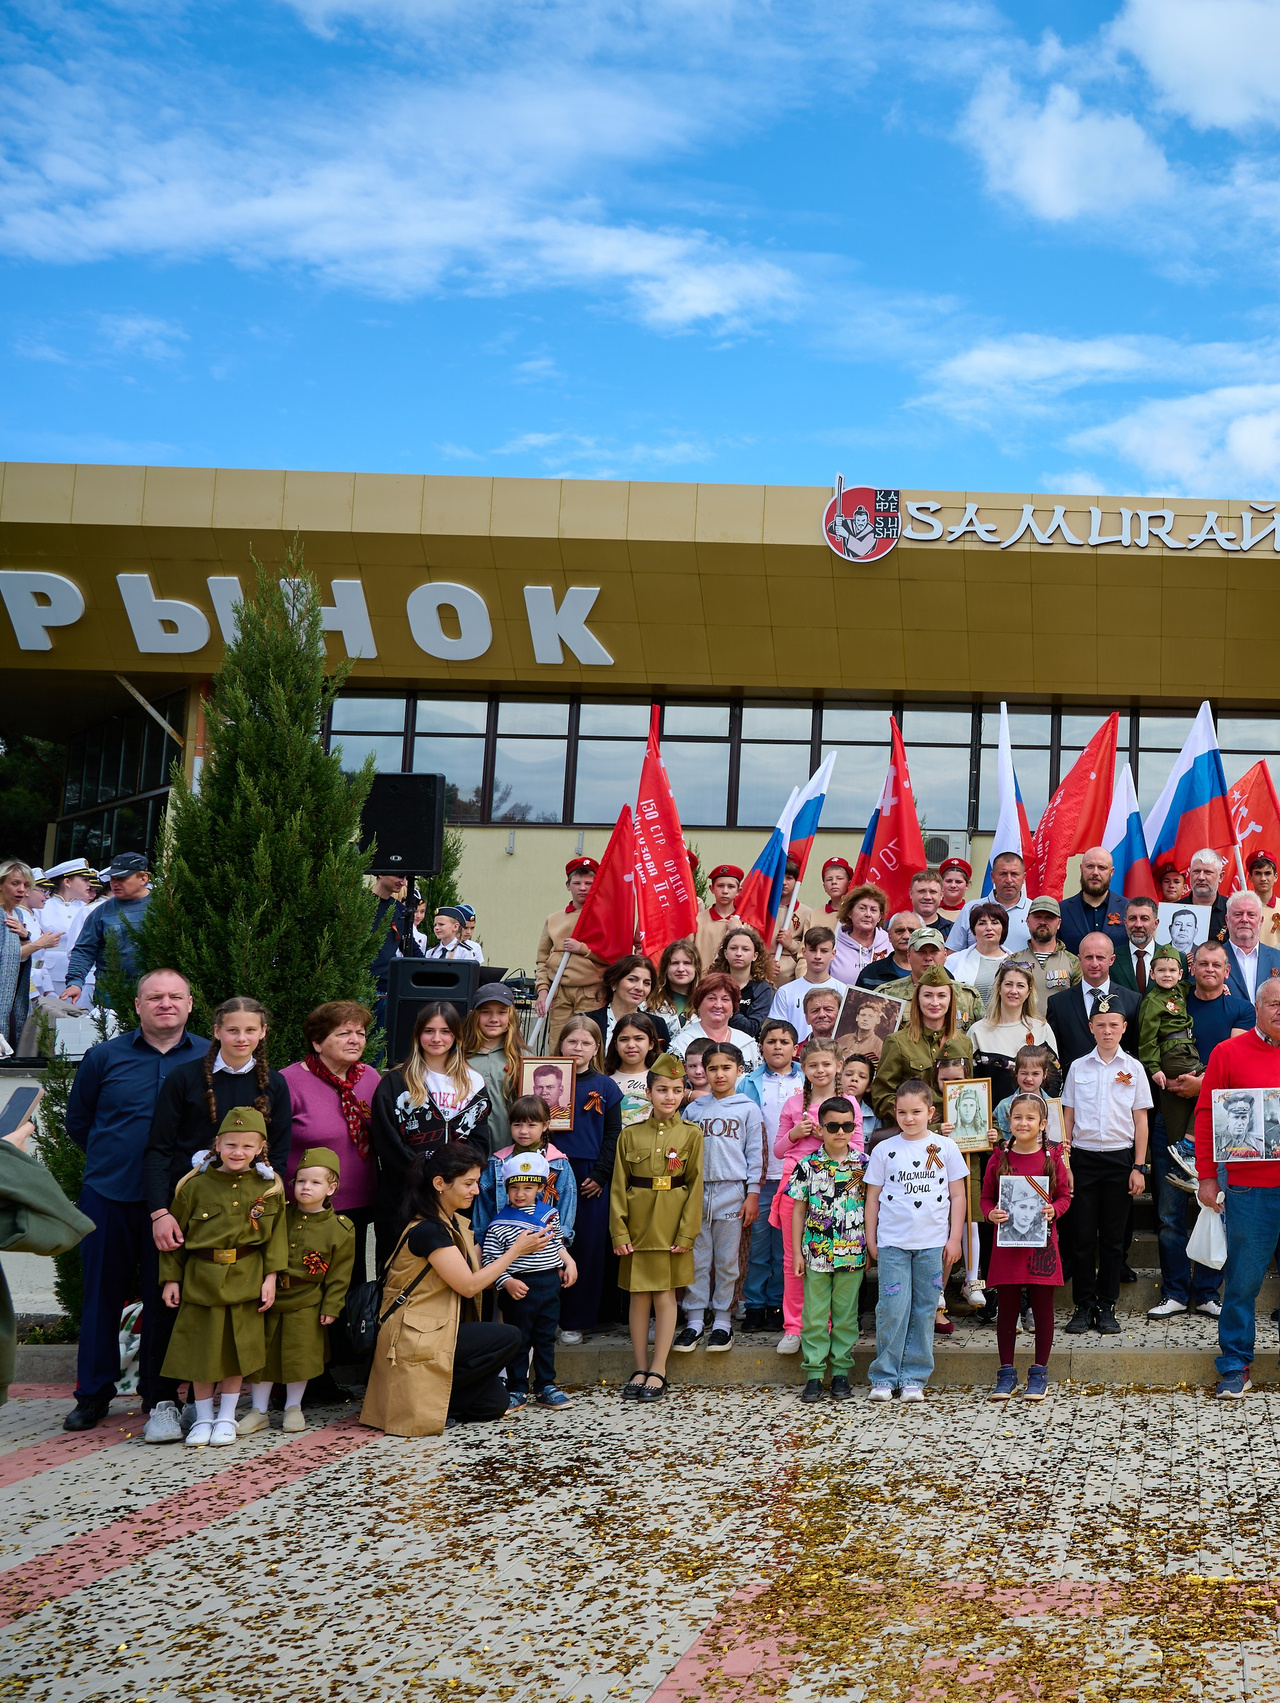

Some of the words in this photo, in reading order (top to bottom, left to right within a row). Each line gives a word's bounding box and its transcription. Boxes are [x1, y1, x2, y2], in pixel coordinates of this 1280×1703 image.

[876, 490, 898, 502] КА
[876, 502, 898, 512] ФЕ
[875, 517, 898, 528] SU
[875, 528, 898, 538] SHI
[0, 569, 615, 666] РЫНОК
[640, 798, 658, 820] 150
[509, 1175, 542, 1183] КАПИТАН
[897, 1170, 936, 1182] Мамина
[904, 1182, 931, 1195] Доча
